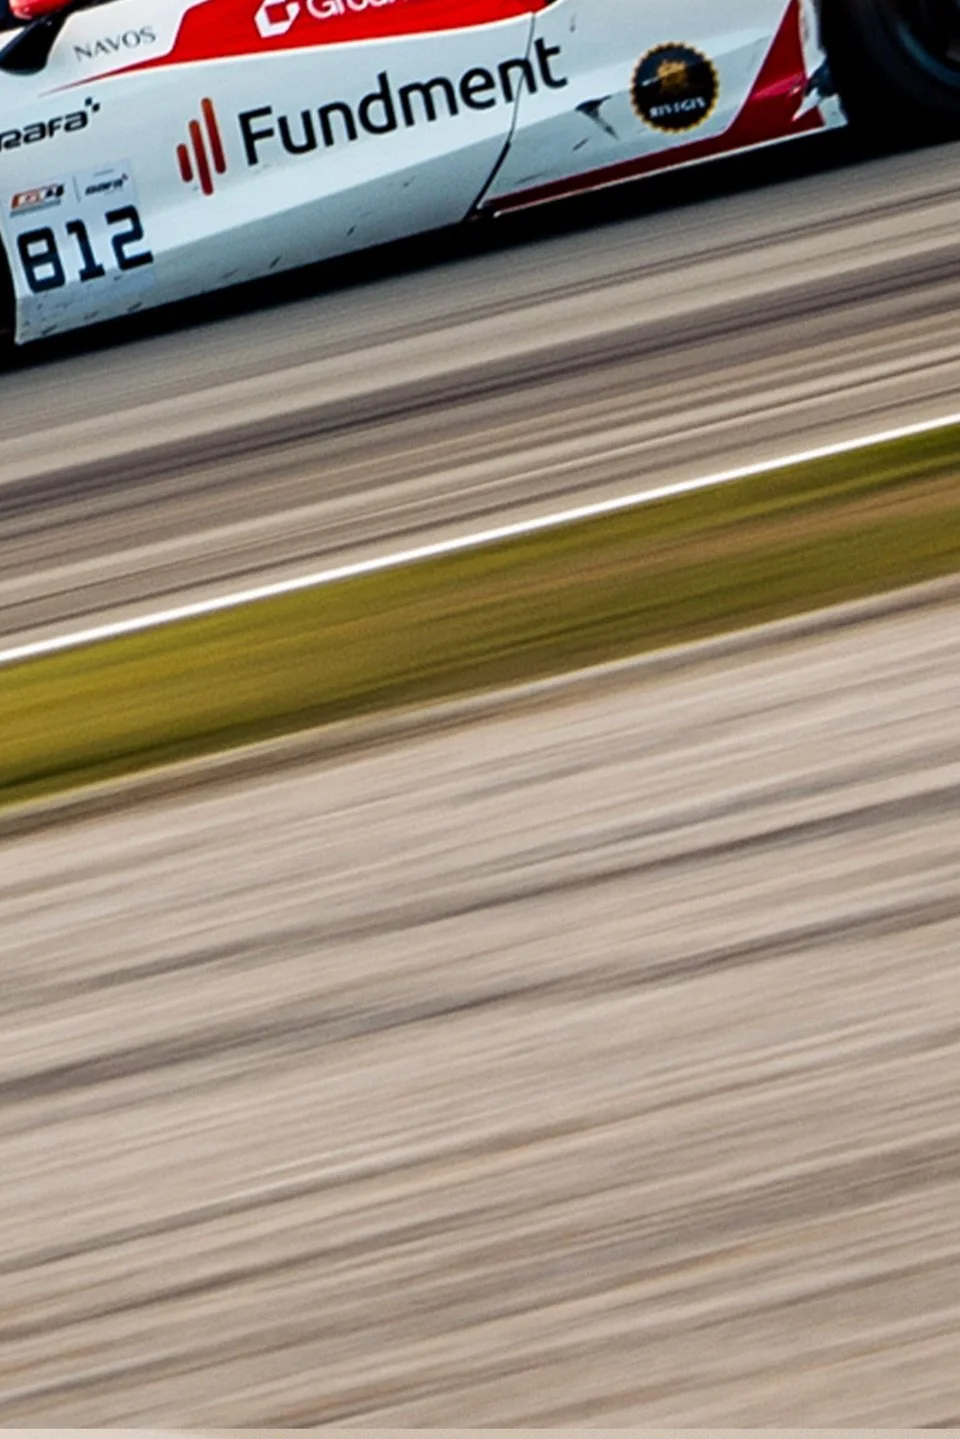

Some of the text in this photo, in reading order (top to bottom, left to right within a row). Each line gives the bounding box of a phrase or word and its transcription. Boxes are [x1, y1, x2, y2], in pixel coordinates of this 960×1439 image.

[74, 25, 157, 62] NAVOS
[239, 37, 568, 167] Fundment
[17, 204, 154, 294] 812
